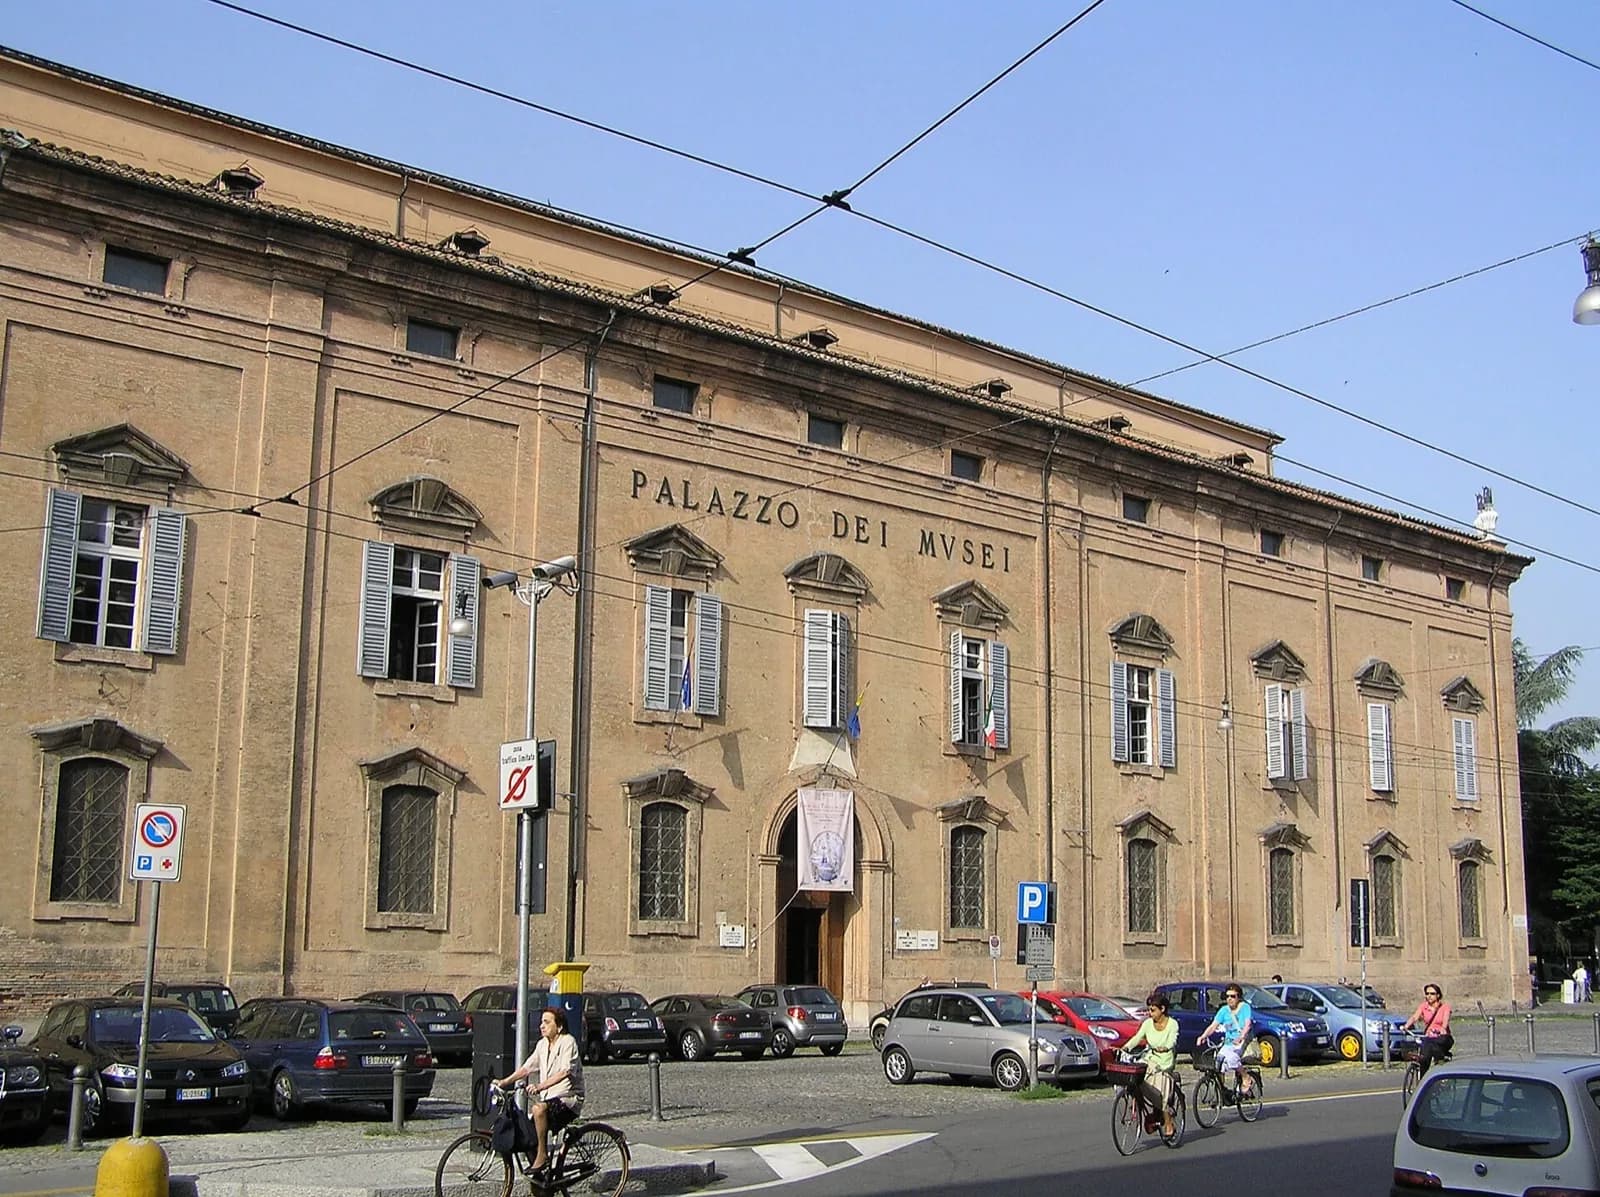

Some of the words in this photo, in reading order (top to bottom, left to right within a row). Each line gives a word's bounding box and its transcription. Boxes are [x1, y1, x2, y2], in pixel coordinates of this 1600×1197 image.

[631, 468, 799, 529] PALAZZO
[832, 510, 887, 548] DEI
[918, 529, 1010, 573] MVSEI
[140, 857, 150, 869] P
[1023, 886, 1042, 918] P
